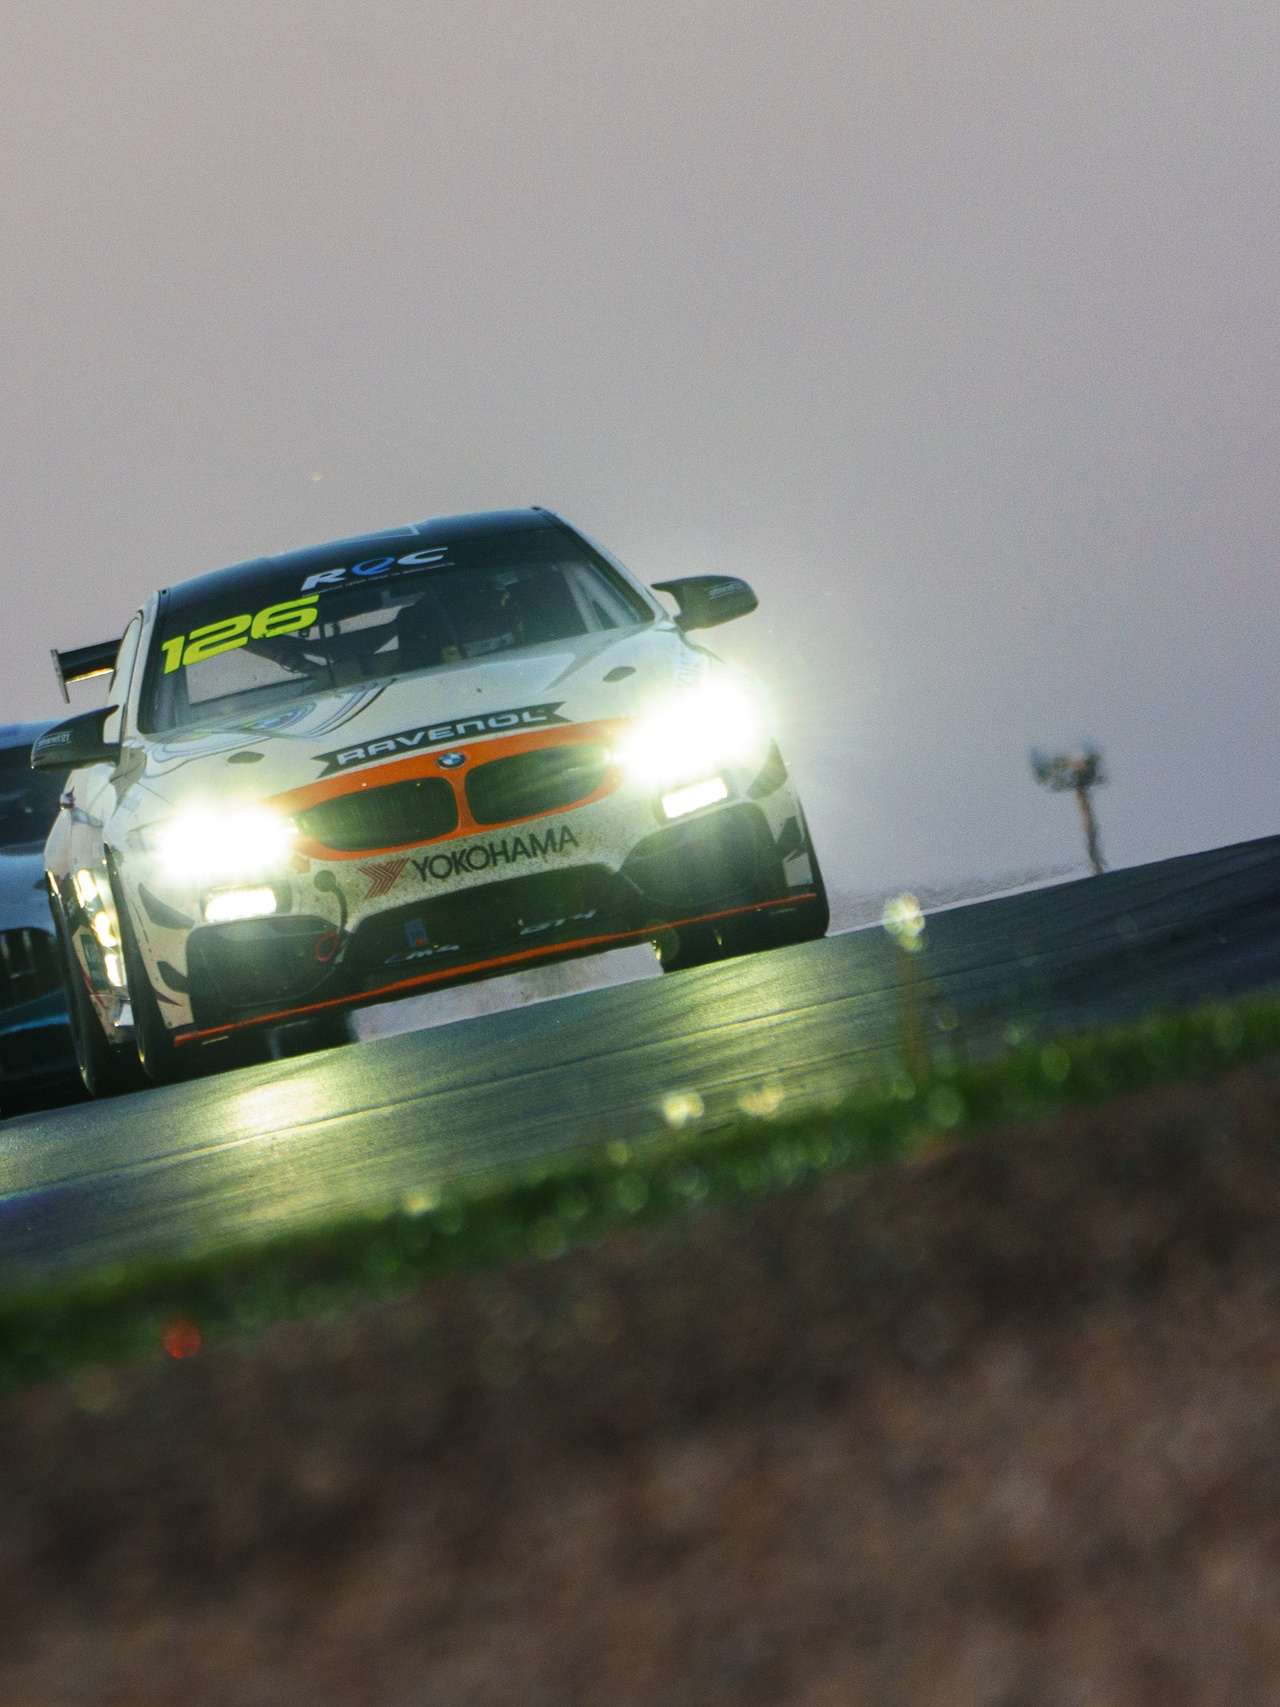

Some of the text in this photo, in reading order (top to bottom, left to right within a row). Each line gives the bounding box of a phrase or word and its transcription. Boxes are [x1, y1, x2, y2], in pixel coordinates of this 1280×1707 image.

[161, 594, 320, 675] 126
[336, 708, 548, 767] RAVENOL
[411, 824, 580, 882] YOKOHAMA
